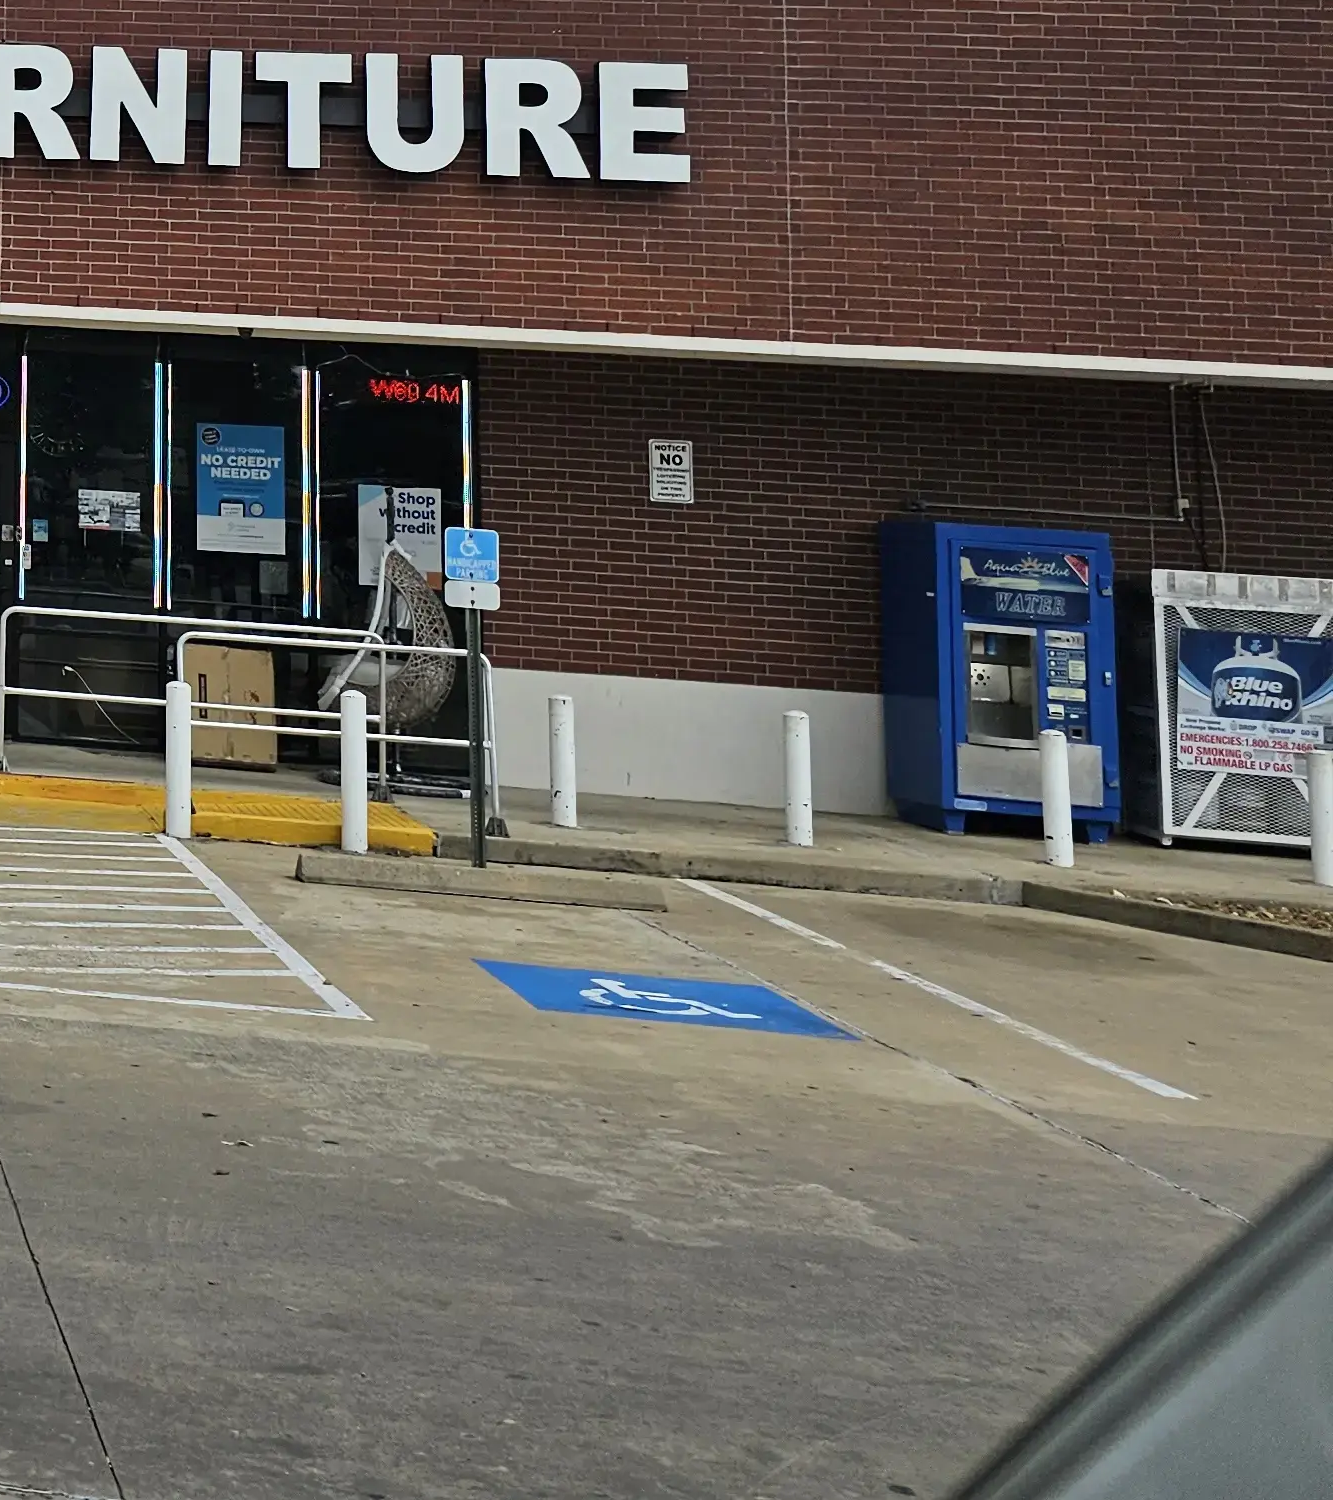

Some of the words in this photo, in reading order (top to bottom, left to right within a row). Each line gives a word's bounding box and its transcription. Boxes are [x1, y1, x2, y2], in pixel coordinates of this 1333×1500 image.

[654, 444, 687, 452] NOTICE
[200, 454, 224, 466] NO
[226, 455, 282, 469] CREDIT
[660, 453, 683, 466] NO
[211, 467, 271, 480] NEEDED
[398, 492, 436, 508] Shop
[379, 506, 436, 520] wthout
[394, 522, 436, 535] credit
[983, 559, 1020, 576] Aqua
[1040, 561, 1070, 576] Blue
[995, 592, 1067, 616] WATER
[1231, 677, 1283, 694] Blue
[1225, 691, 1293, 711] Rhino
[1275, 727, 1296, 735] SWAP
[1180, 746, 1193, 755] NO
[1195, 746, 1242, 759] SMOKING
[1194, 756, 1256, 770] FLAMMABLE
[1259, 760, 1271, 771] LP
[1273, 762, 1293, 773] GAS
